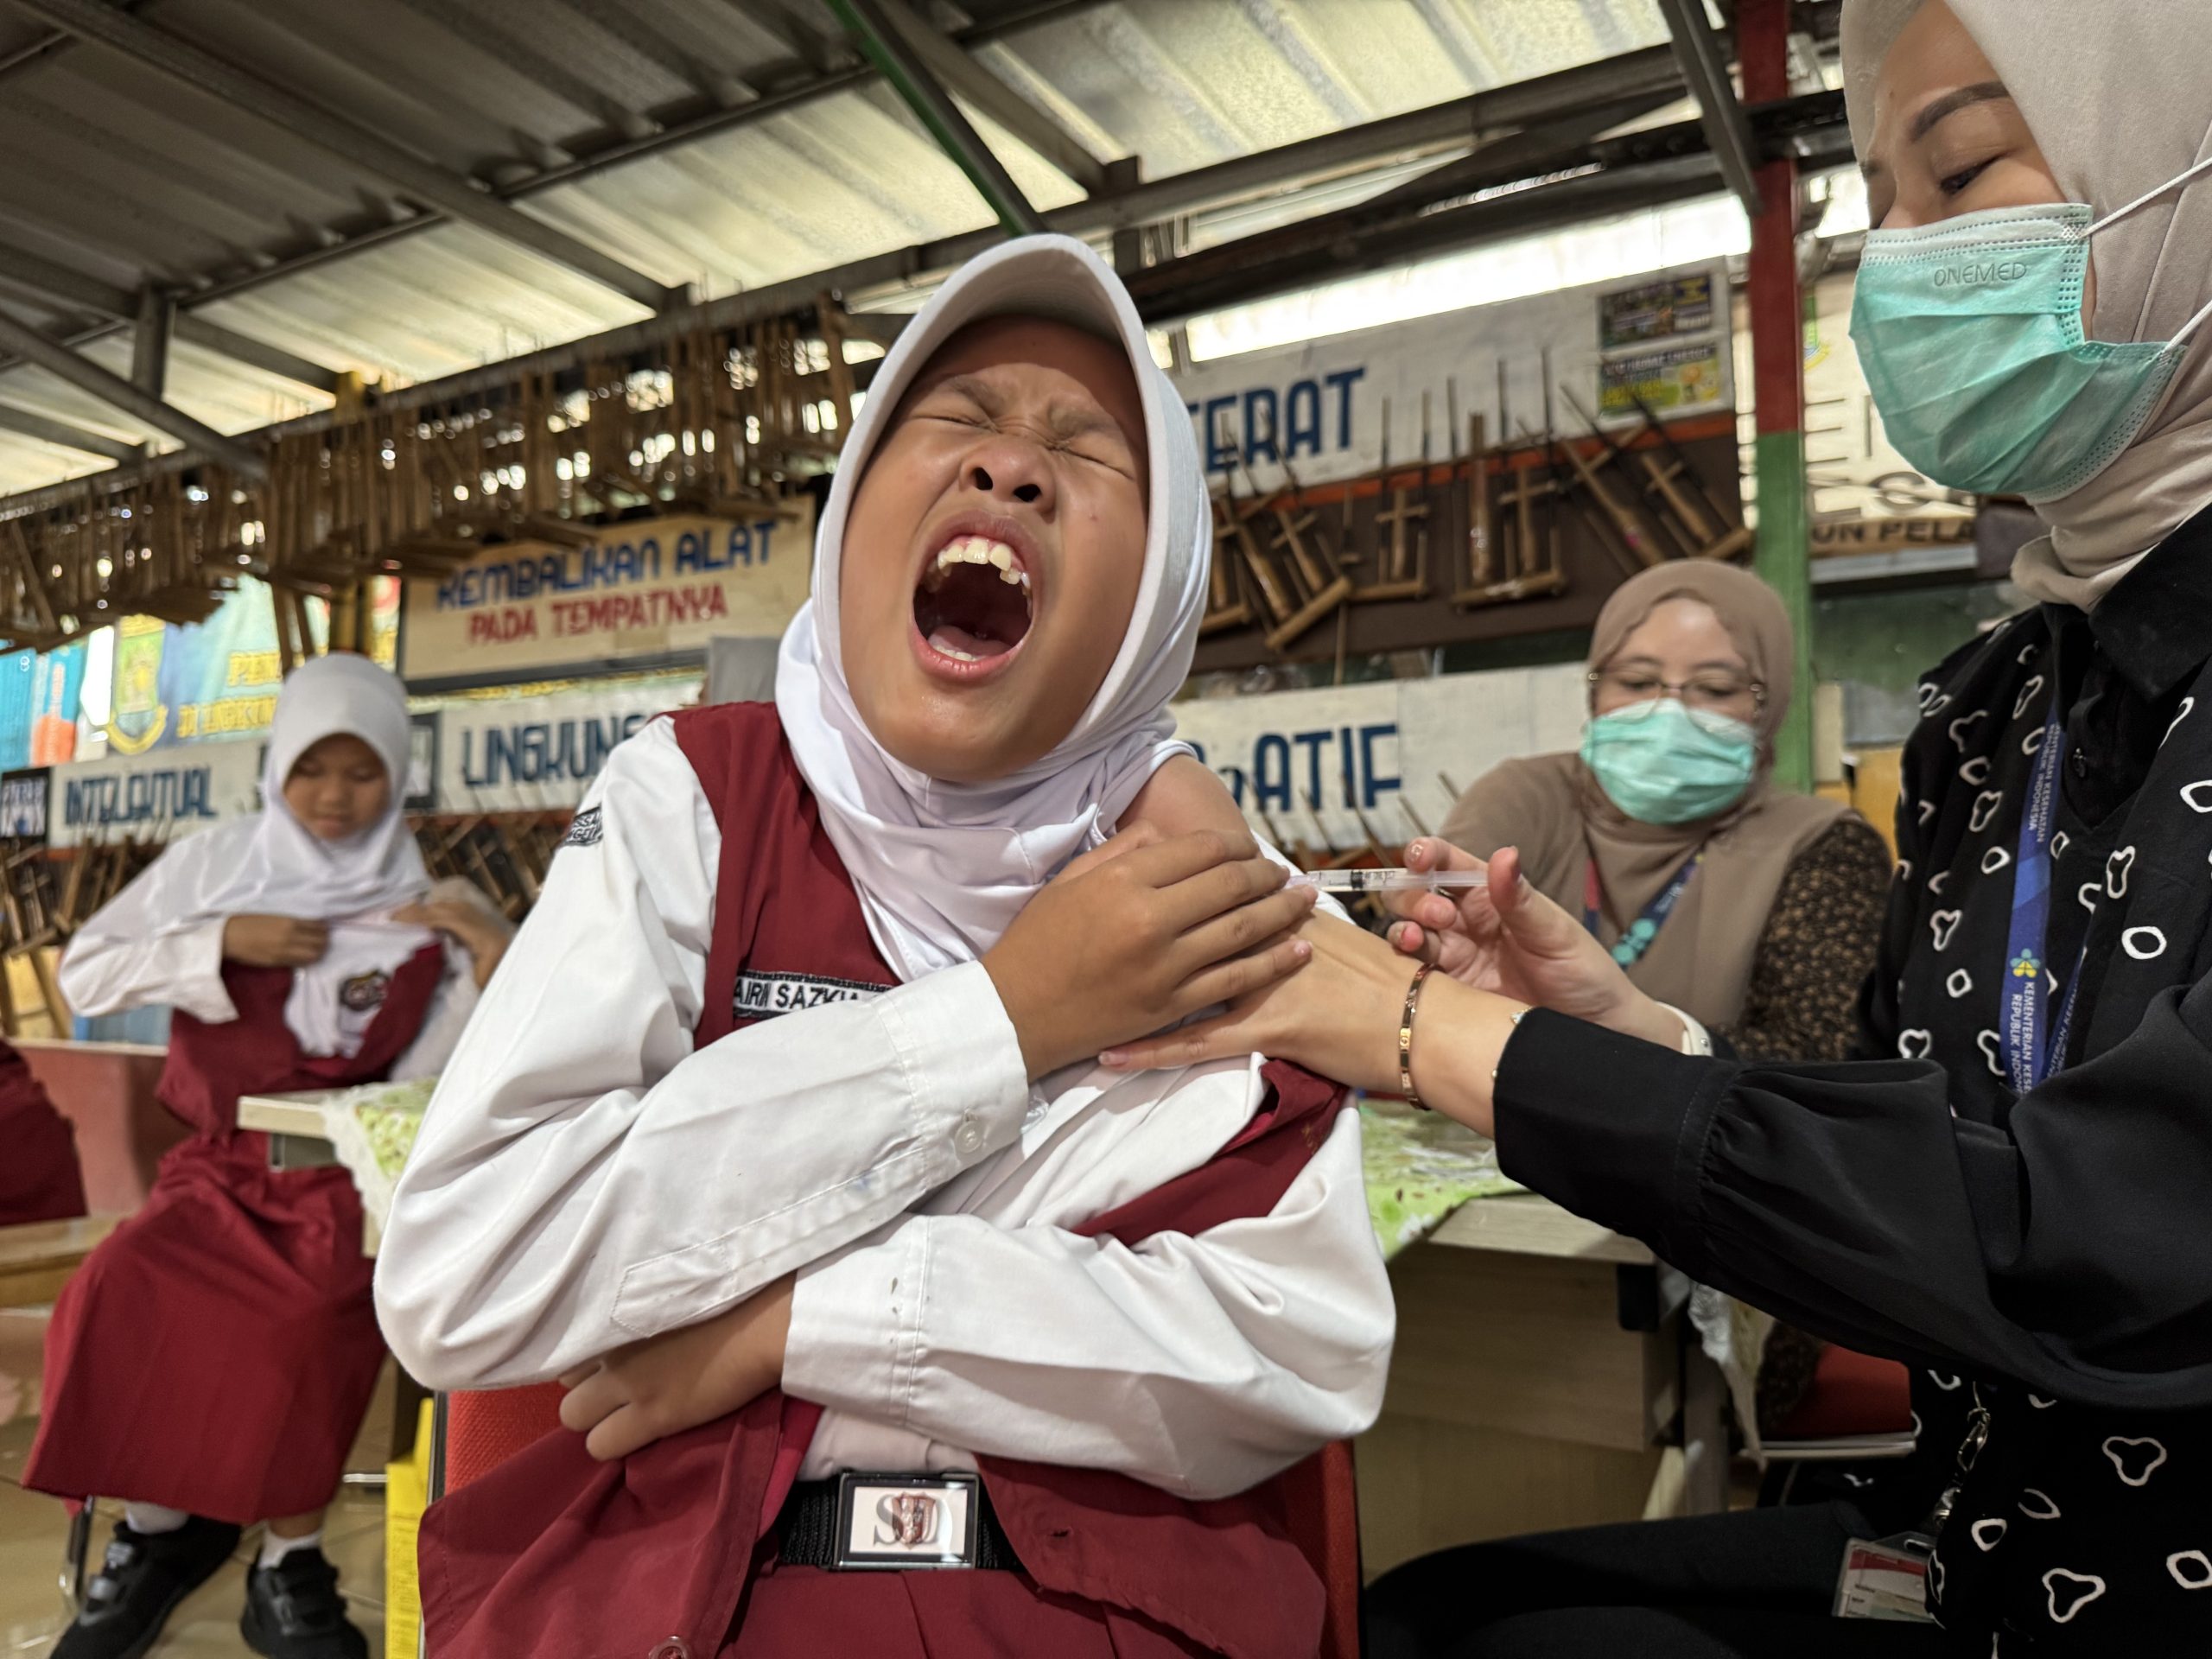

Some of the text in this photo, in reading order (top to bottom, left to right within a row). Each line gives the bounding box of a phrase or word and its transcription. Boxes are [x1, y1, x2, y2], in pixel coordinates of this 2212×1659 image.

[1933, 262, 2027, 287] ONEMED
[1187, 366, 1364, 472] ERAT
[438, 520, 778, 612] KEMBALIKAN ALAT
[1811, 524, 1865, 544] UN
[469, 583, 728, 642] PADA TEMPATNYA
[1199, 722, 1401, 814] ATIF
[2010, 993, 2024, 1047] REPUBLIK
[2022, 982, 2036, 1061] KEMENTERIAN
